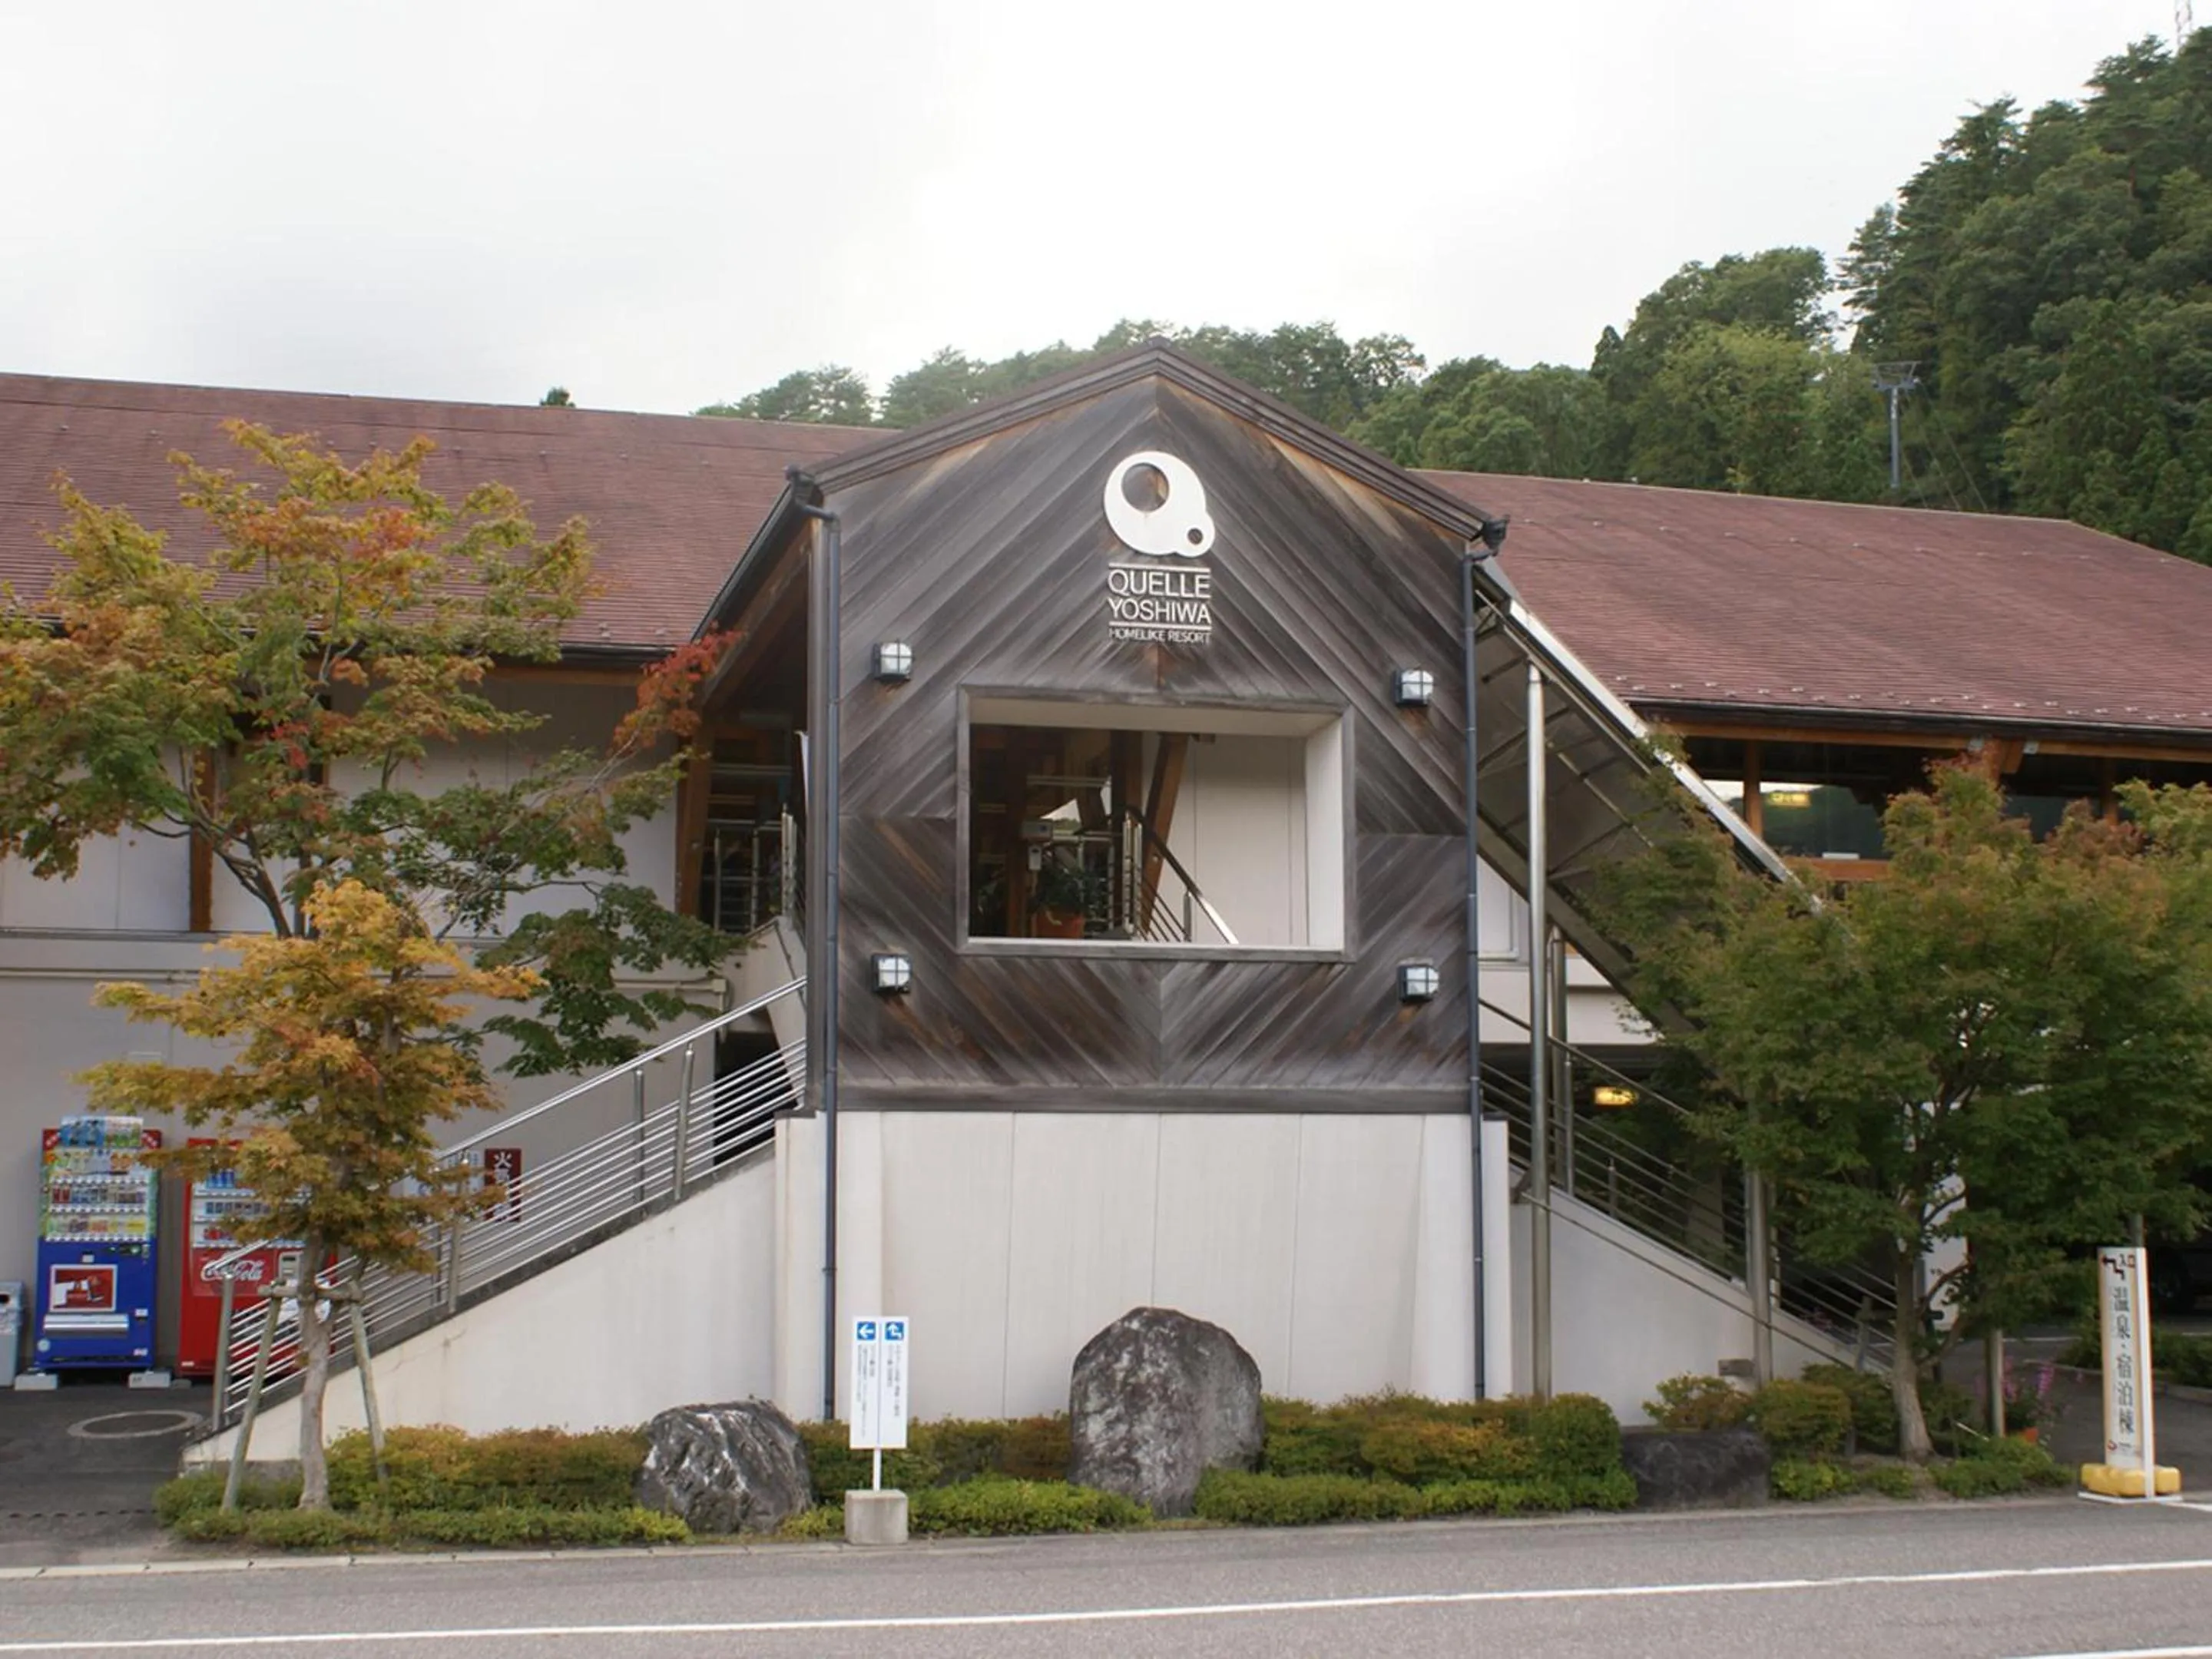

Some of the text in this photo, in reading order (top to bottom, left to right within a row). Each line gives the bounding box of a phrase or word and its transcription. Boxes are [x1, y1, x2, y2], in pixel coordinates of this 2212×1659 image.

[1108, 568, 1211, 598] QUELLE
[1108, 597, 1212, 624] YOSHIWA
[1108, 628, 1211, 644] HOMELIKE RESORT
[200, 1259, 266, 1282] CoCola
